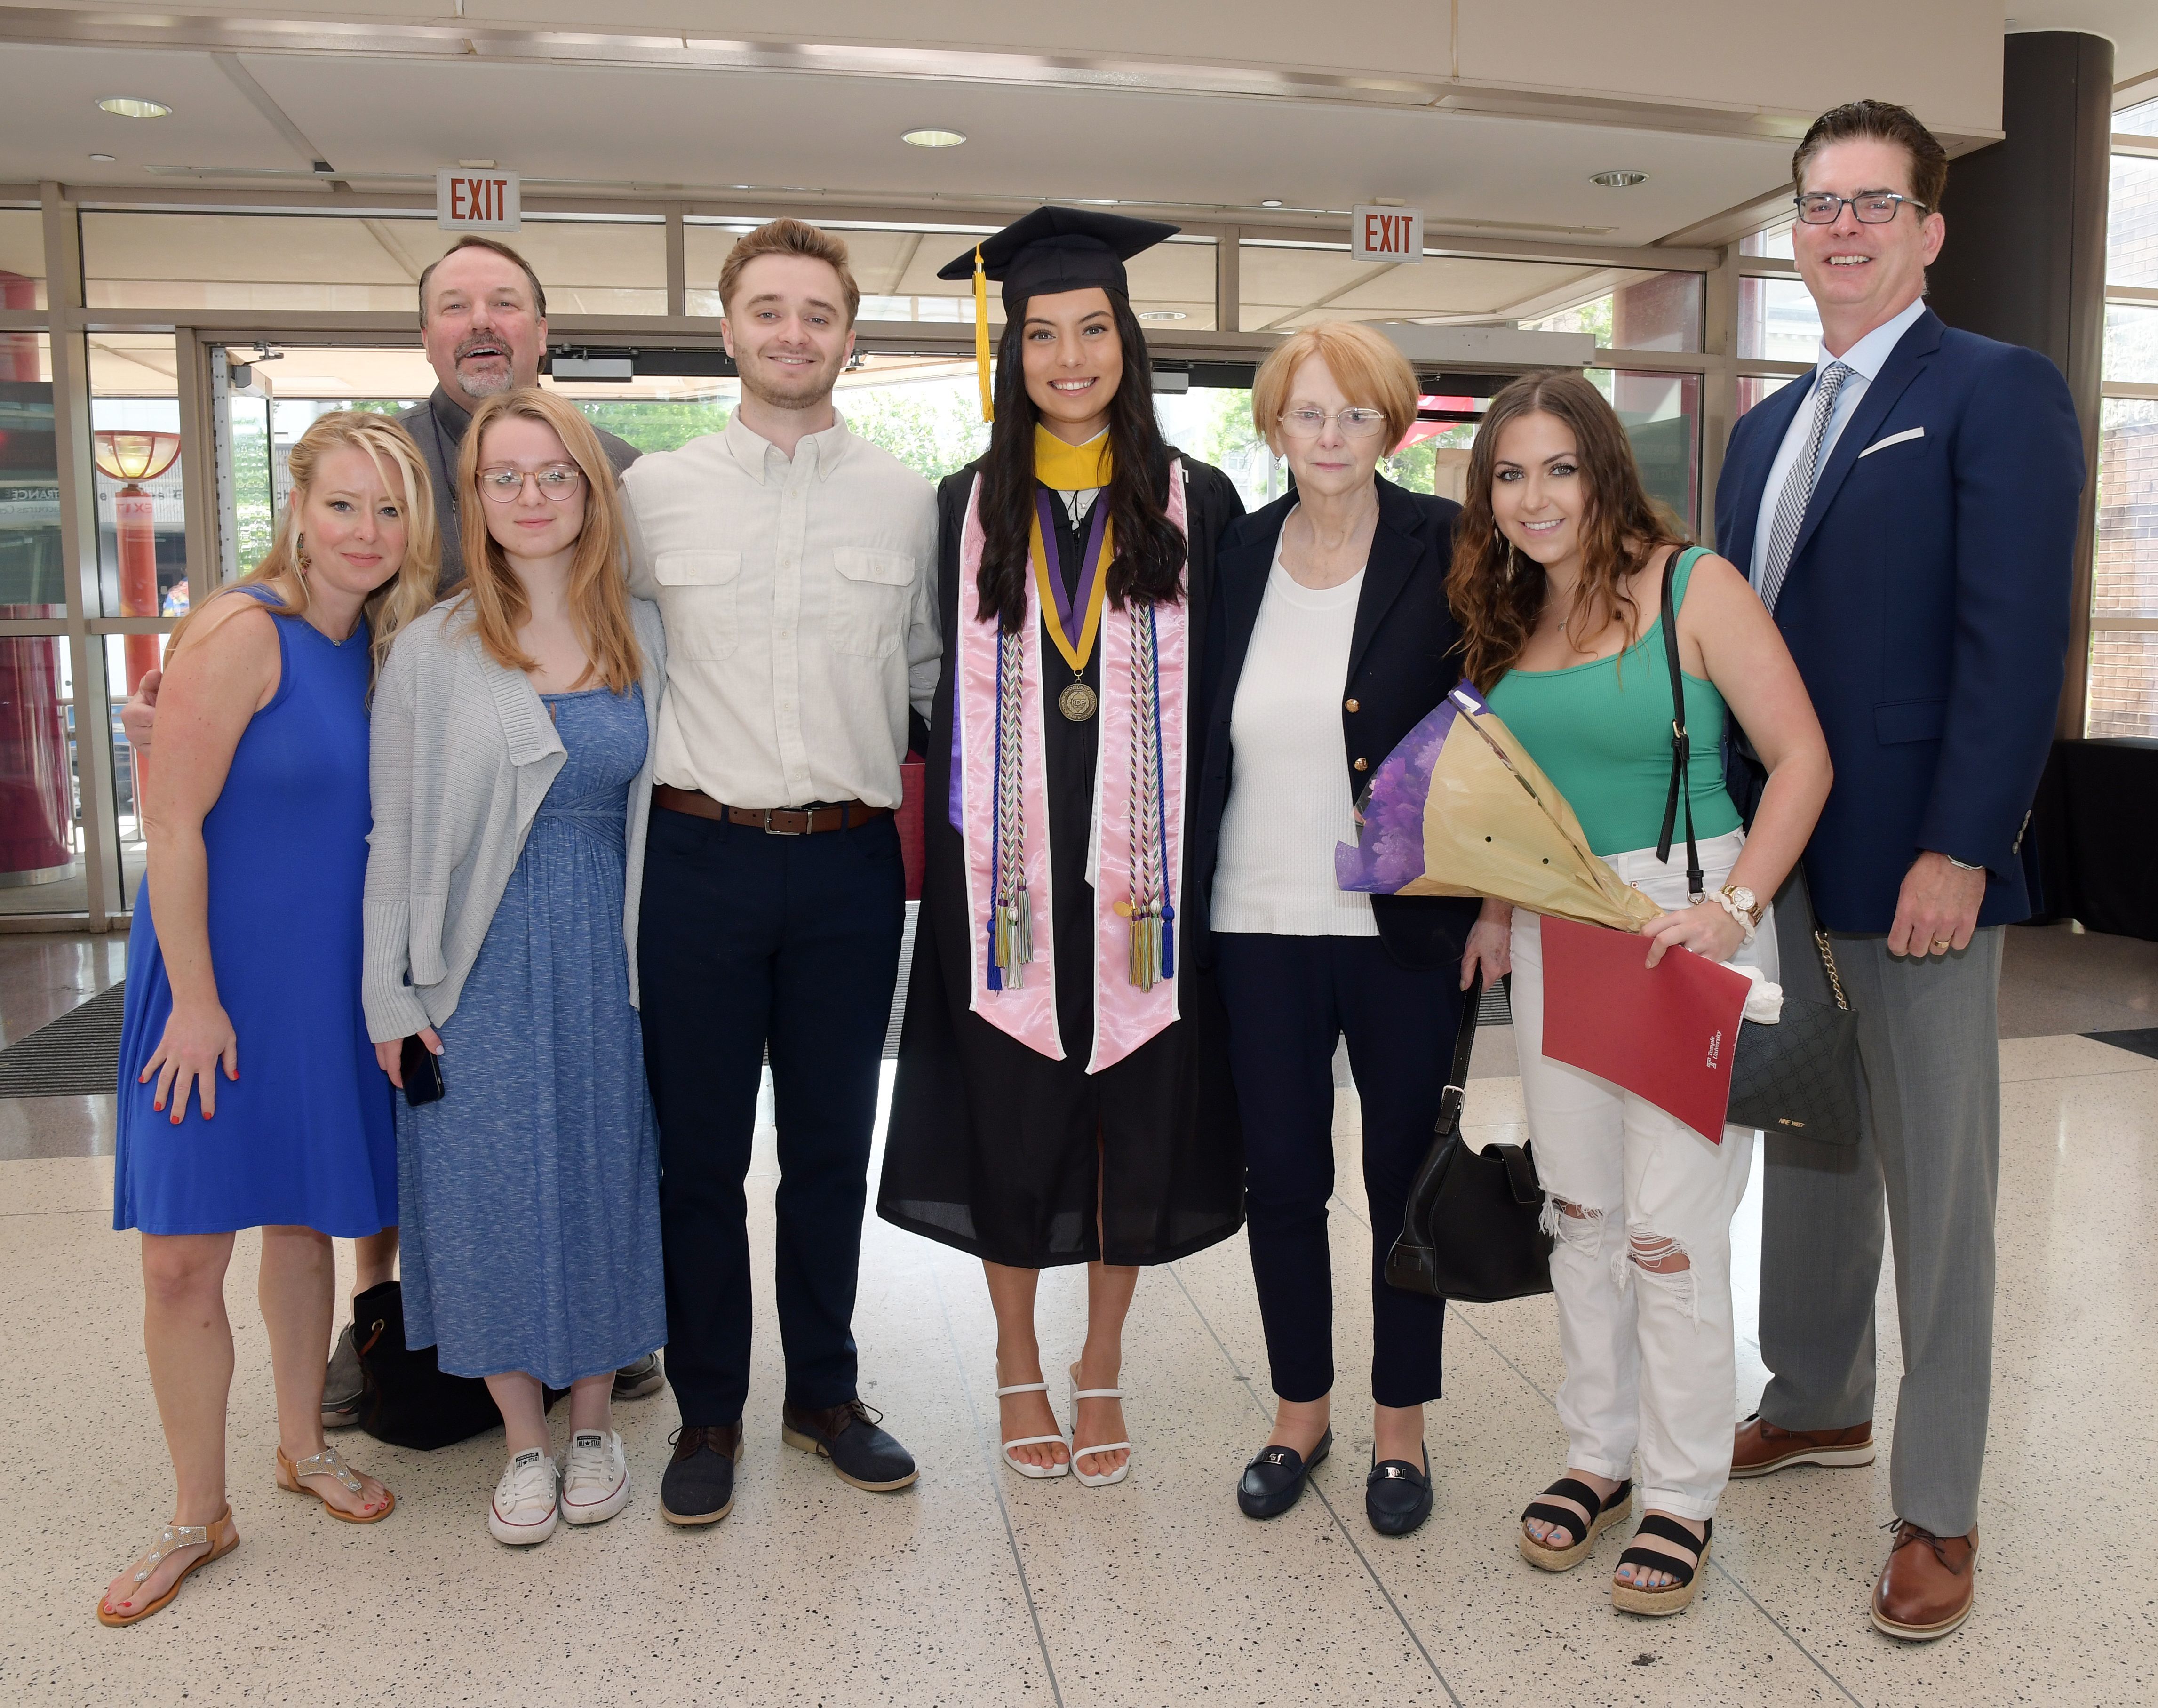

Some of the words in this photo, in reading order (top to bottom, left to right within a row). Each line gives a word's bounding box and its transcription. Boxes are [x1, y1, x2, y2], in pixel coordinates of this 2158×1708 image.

[451, 178, 507, 221] EXIT
[1365, 214, 1413, 253] EXIT
[1712, 1030, 1722, 1060] University
